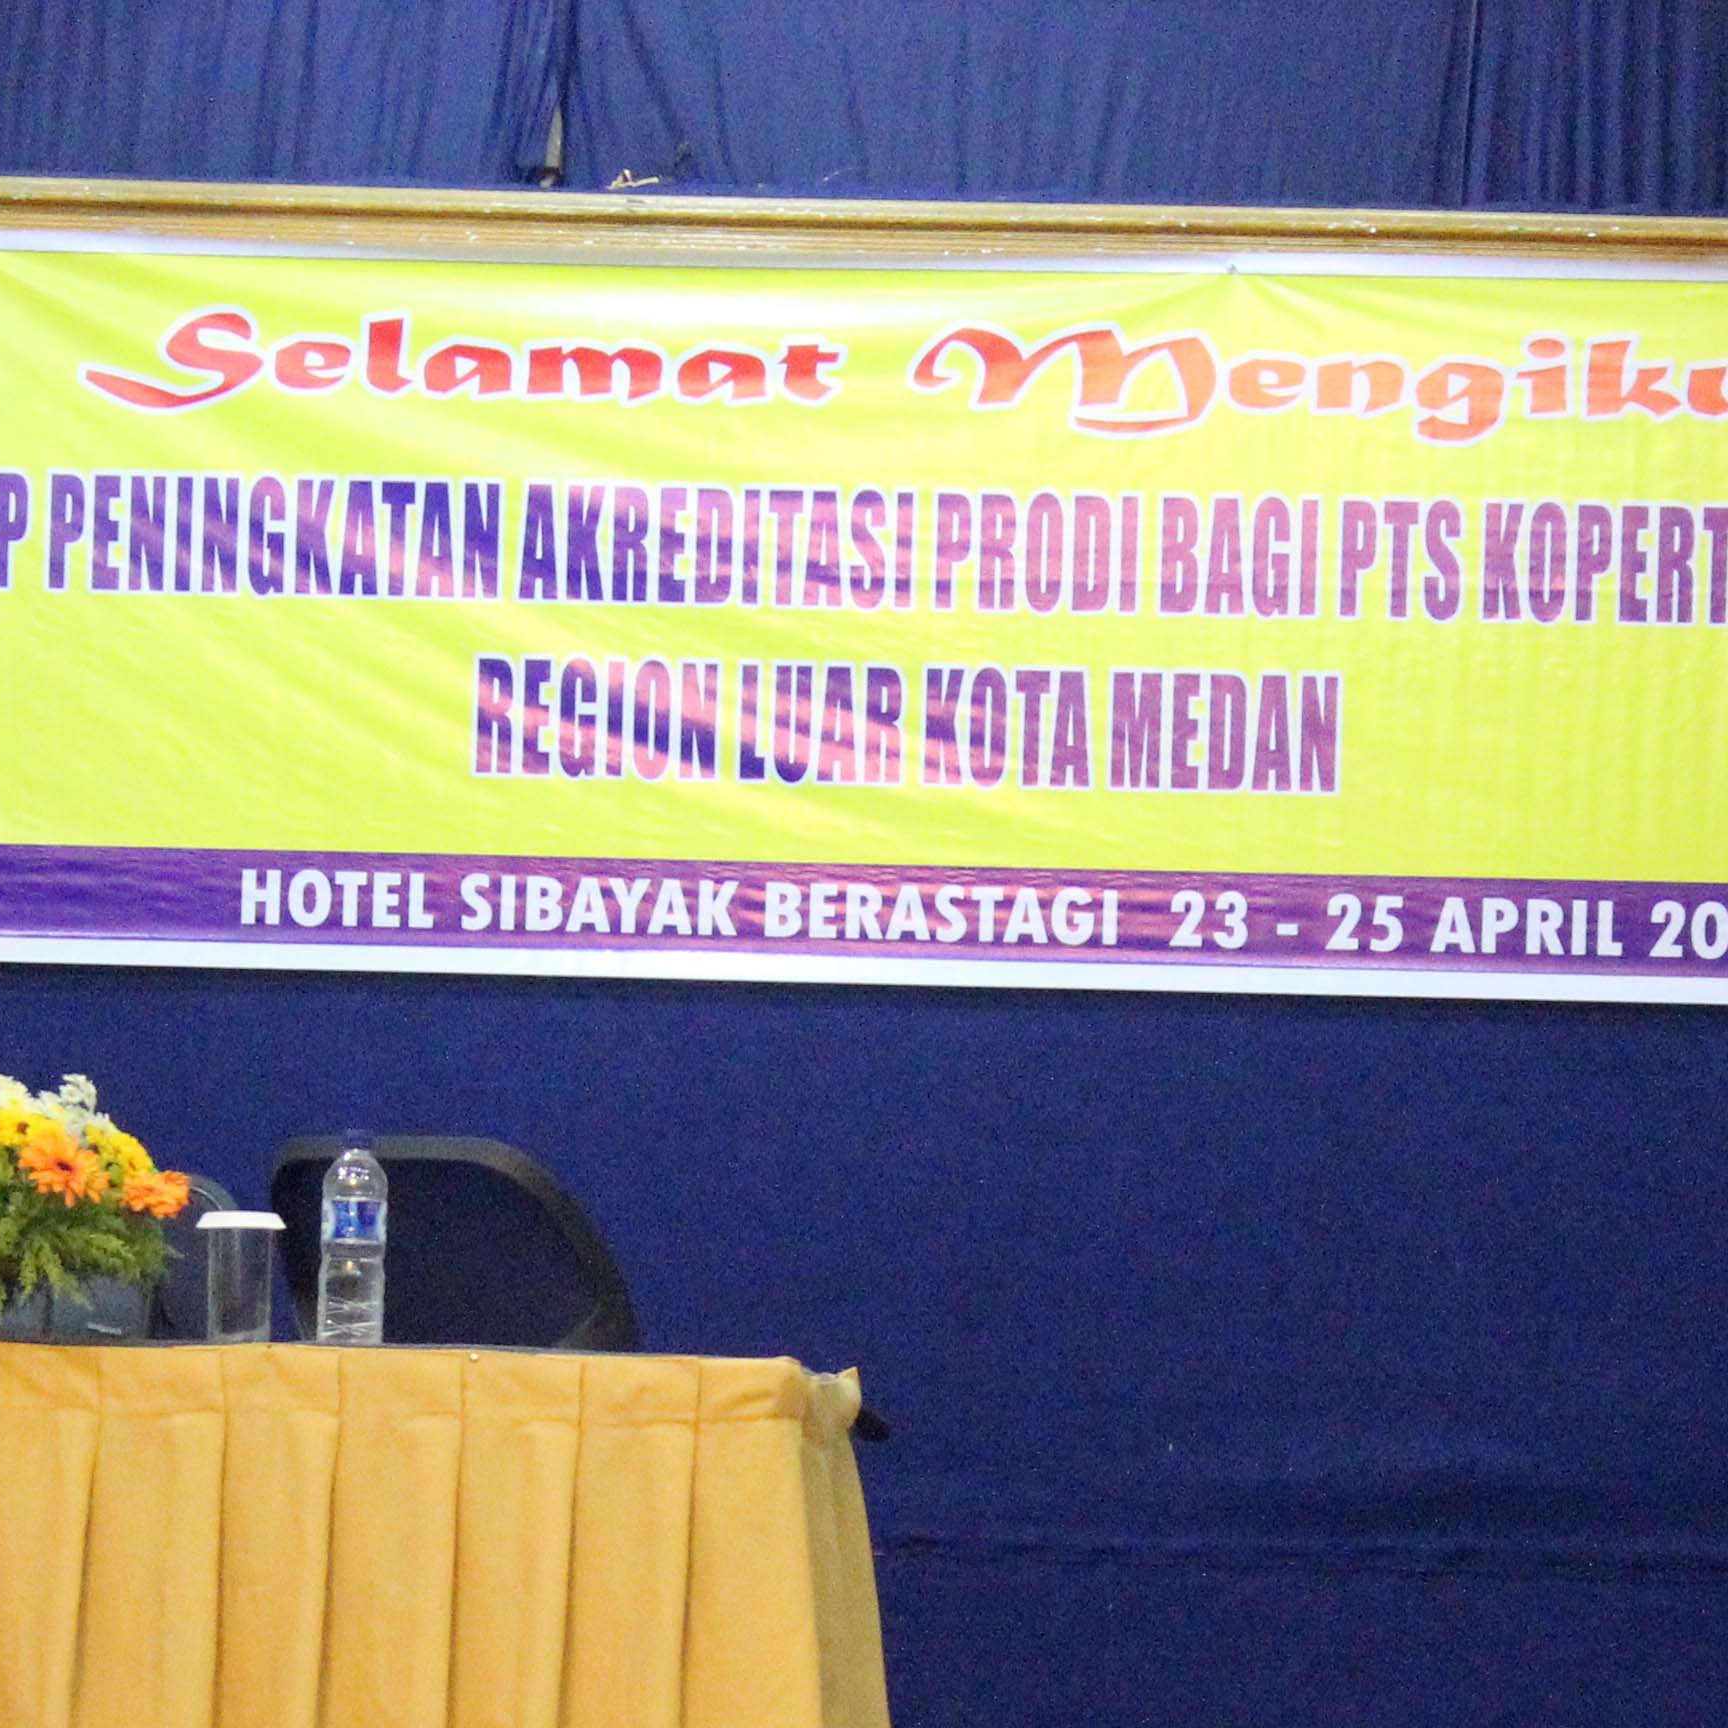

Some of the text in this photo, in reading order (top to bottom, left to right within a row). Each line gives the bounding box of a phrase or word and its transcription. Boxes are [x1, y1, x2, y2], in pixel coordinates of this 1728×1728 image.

[88, 312, 838, 408] Selamat
[49, 475, 499, 595] PENINGKATAN
[520, 486, 912, 605] AKREDITASI
[936, 494, 1136, 610] PRODI
[1161, 499, 1316, 615] BAGI
[1341, 502, 1459, 620] PTS
[477, 659, 1337, 791] REGION LUAR KOTA MEDAN
[242, 870, 433, 927] HOTEL
[461, 874, 738, 935] SIBAYAK
[765, 882, 1118, 946] BERASTAGI
[1170, 891, 1247, 948] 23
[1327, 894, 1402, 951] 25
[1431, 898, 1621, 955] APRIL
